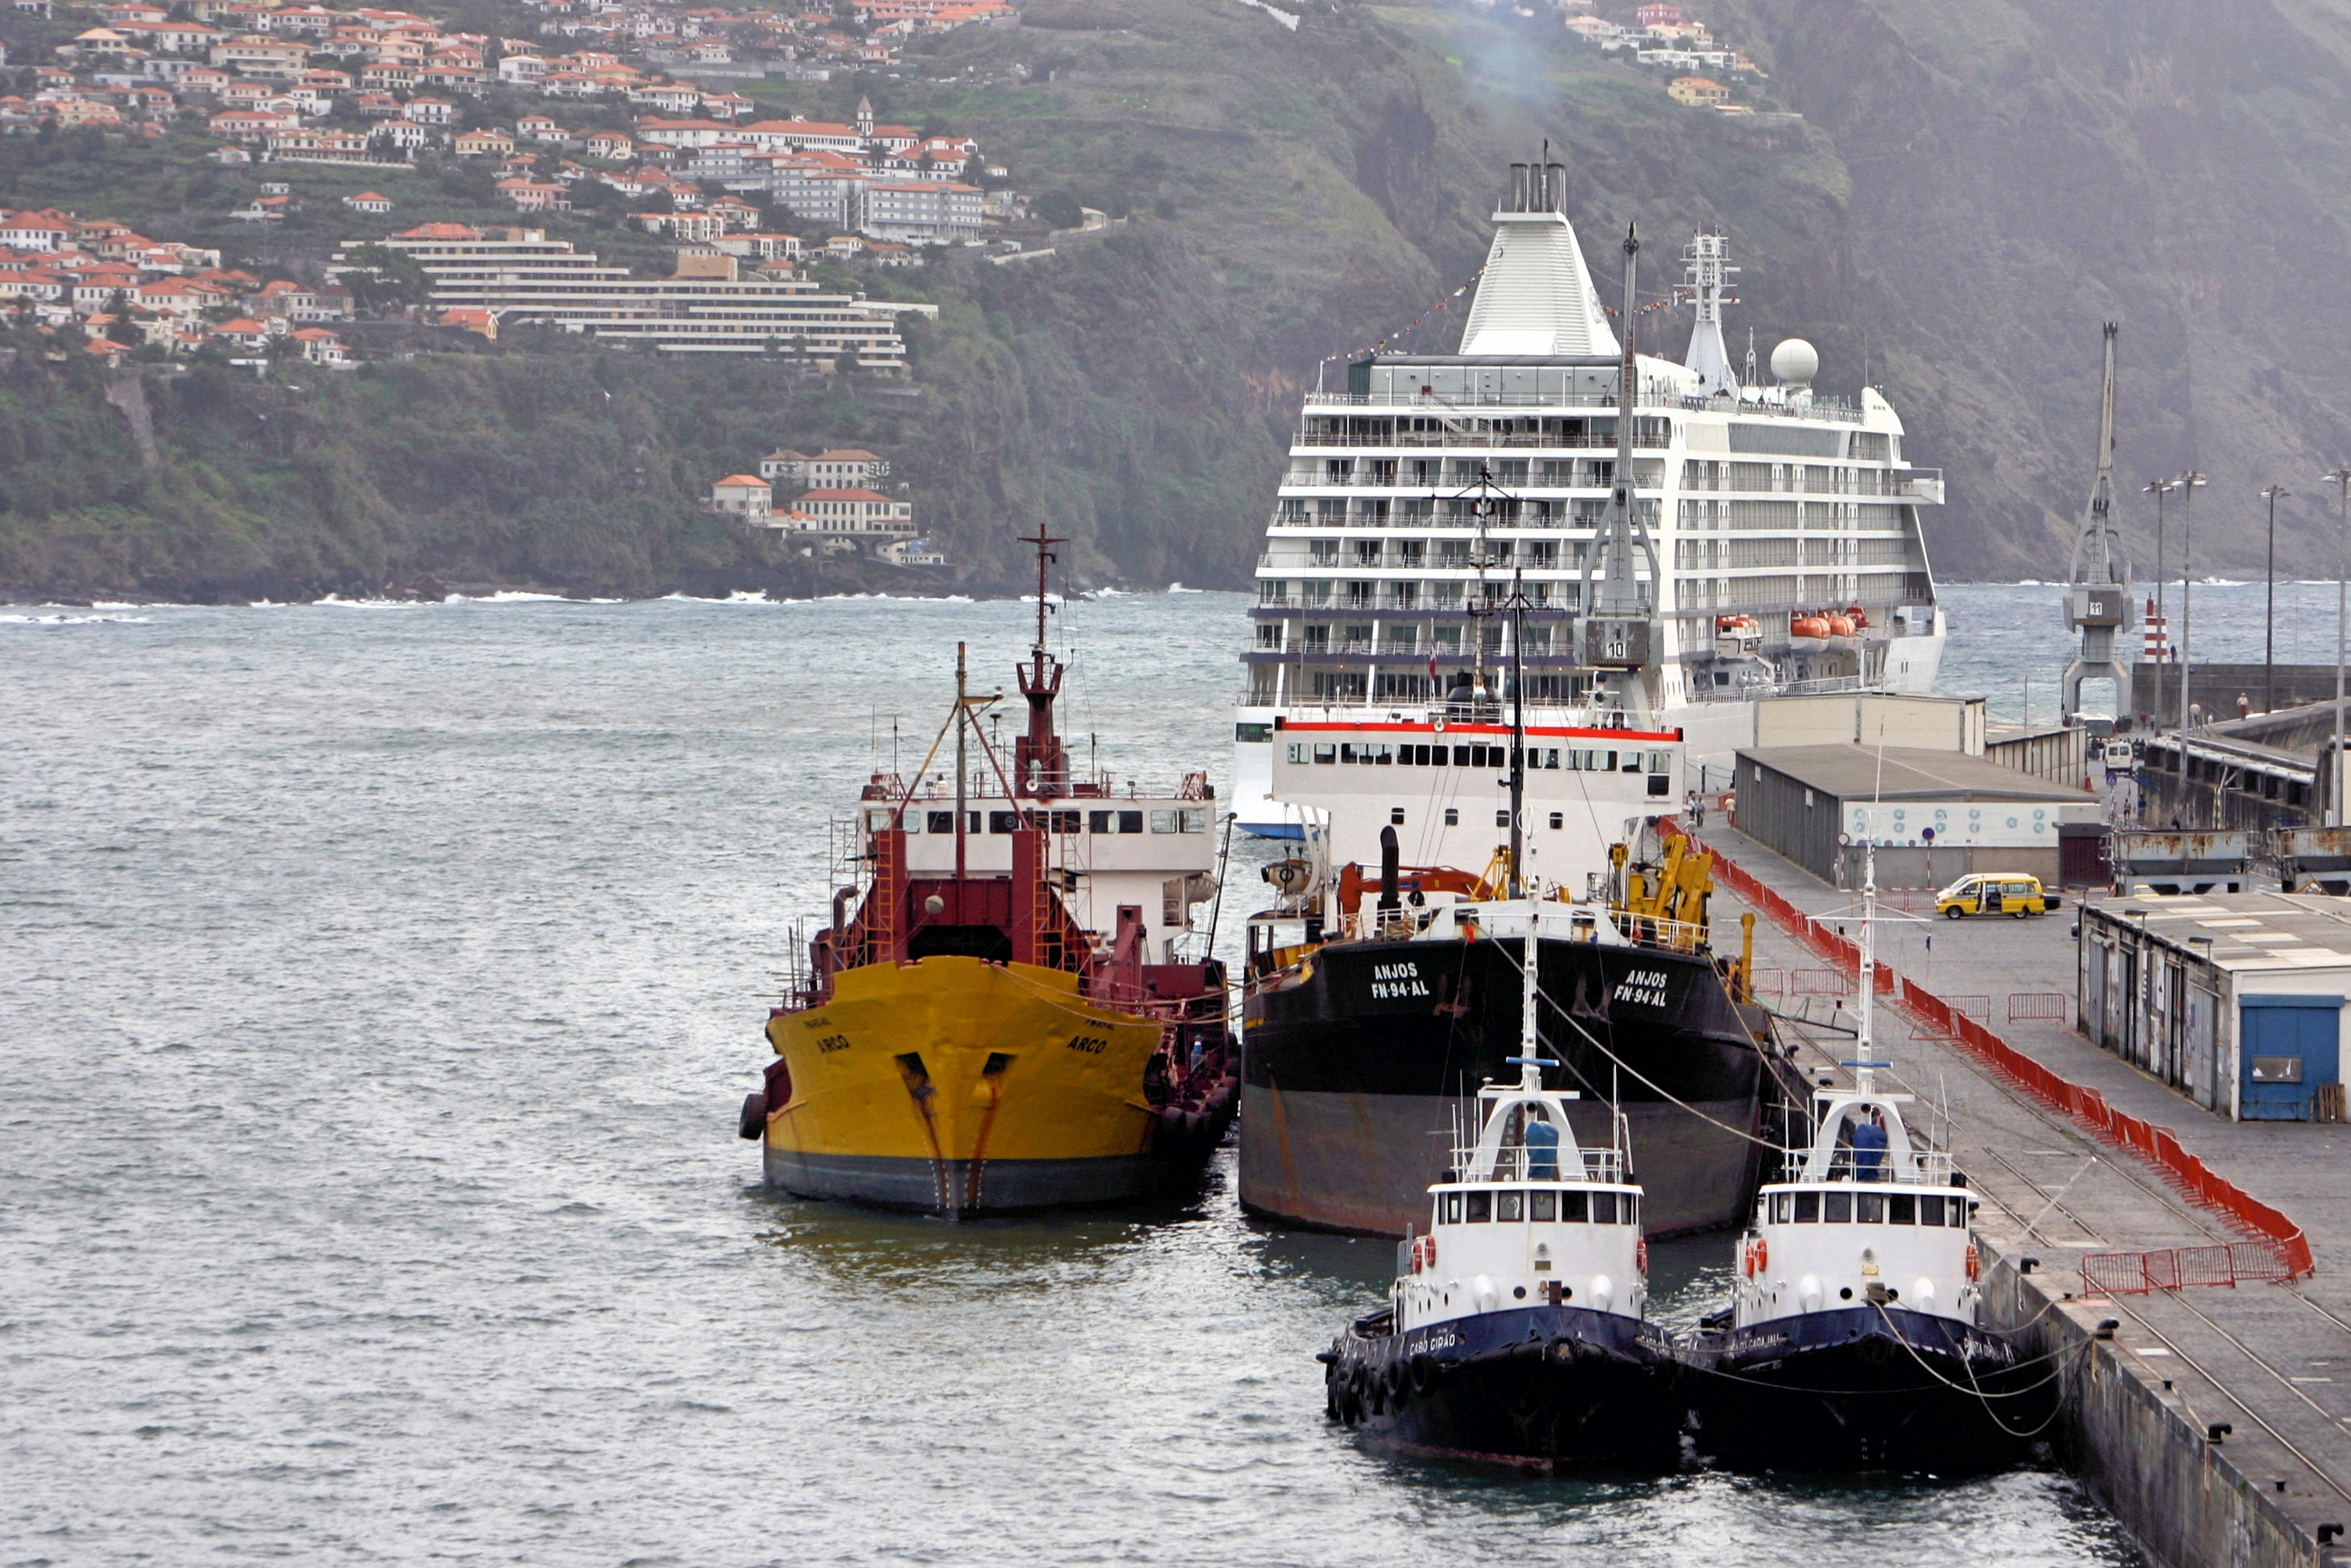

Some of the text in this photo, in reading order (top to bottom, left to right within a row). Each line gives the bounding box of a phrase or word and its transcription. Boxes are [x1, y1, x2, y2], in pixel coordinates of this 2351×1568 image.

[2092, 604, 2101, 614] 11
[1608, 642, 1623, 657] 10
[1374, 962, 1417, 980] ANJOS
[1626, 969, 1668, 988] ANJOS
[816, 1035, 850, 1054] ARCO
[1067, 1036, 1107, 1054] ARCO
[1409, 1340, 1428, 1356] CABO
